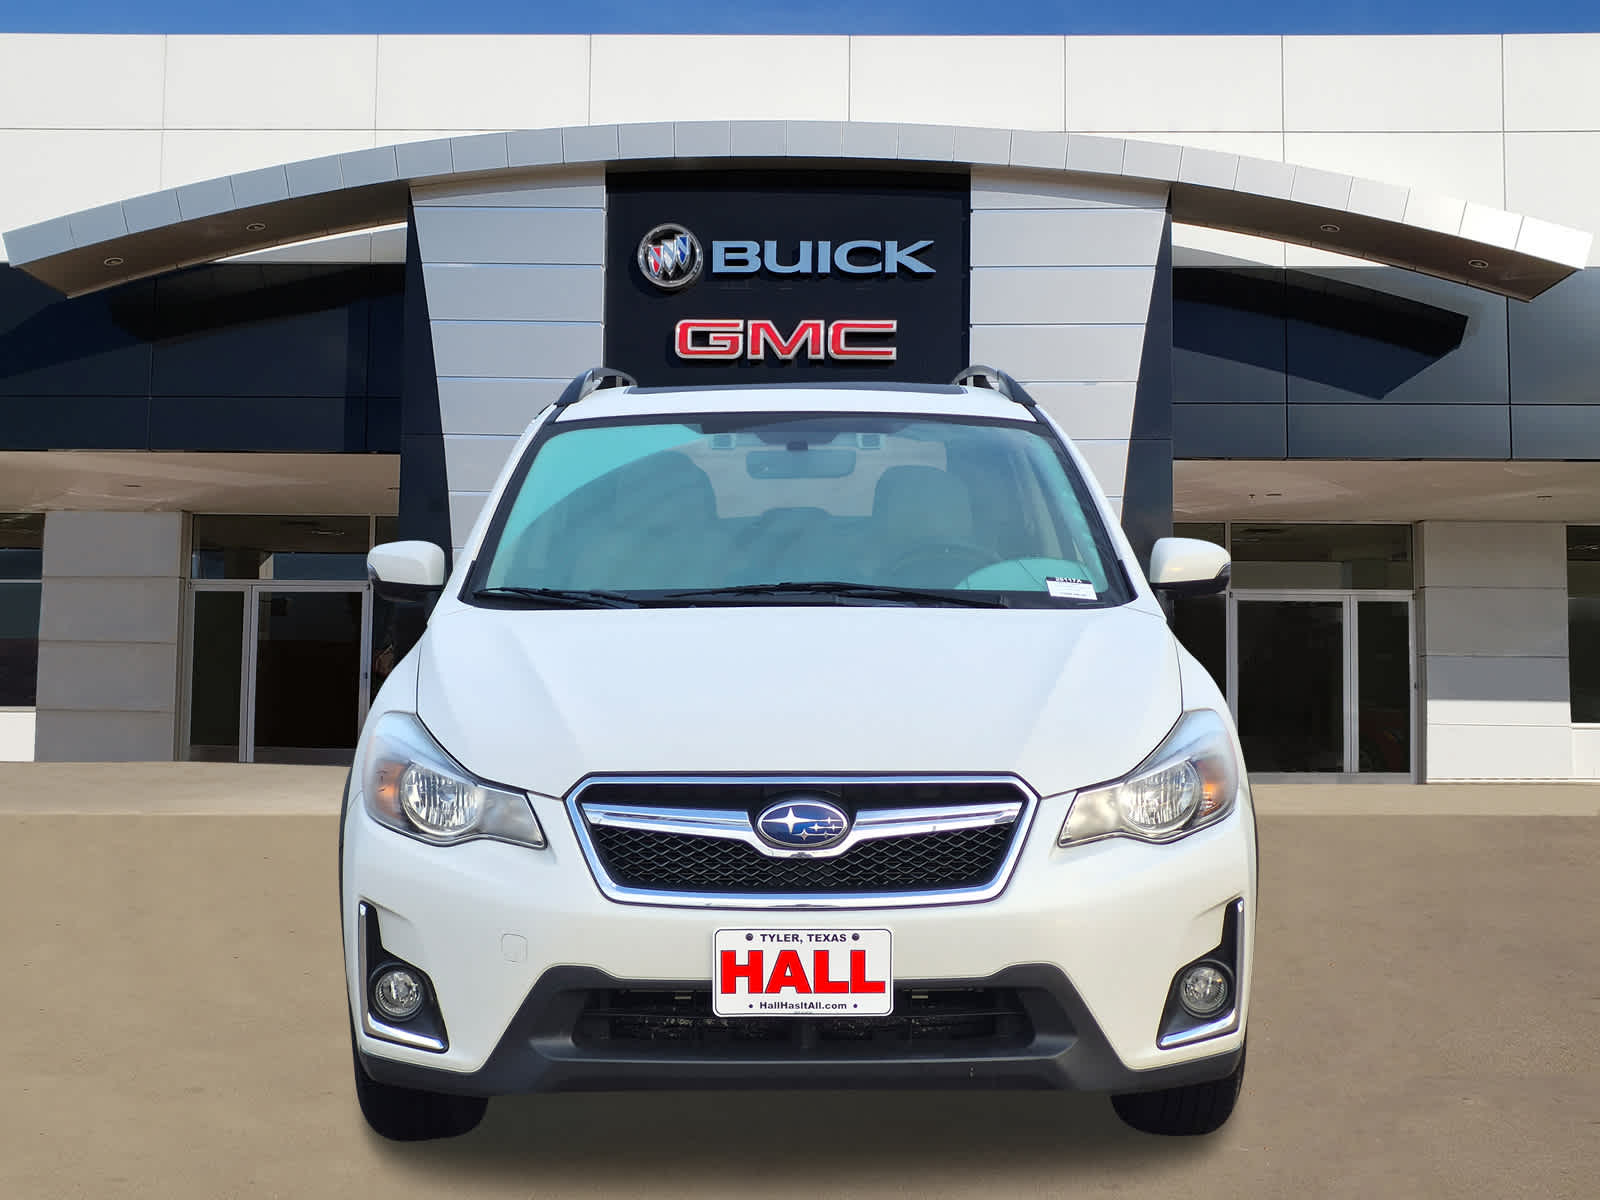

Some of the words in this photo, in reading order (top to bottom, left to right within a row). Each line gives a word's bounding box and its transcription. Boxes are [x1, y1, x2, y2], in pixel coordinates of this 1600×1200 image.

[712, 240, 936, 273] BUICK
[675, 319, 897, 360] GMC
[760, 933, 803, 944] TYLER,
[807, 933, 847, 942] TEXAS
[720, 950, 886, 994] HALL
[759, 1001, 847, 1010] HallHasItAll.com
